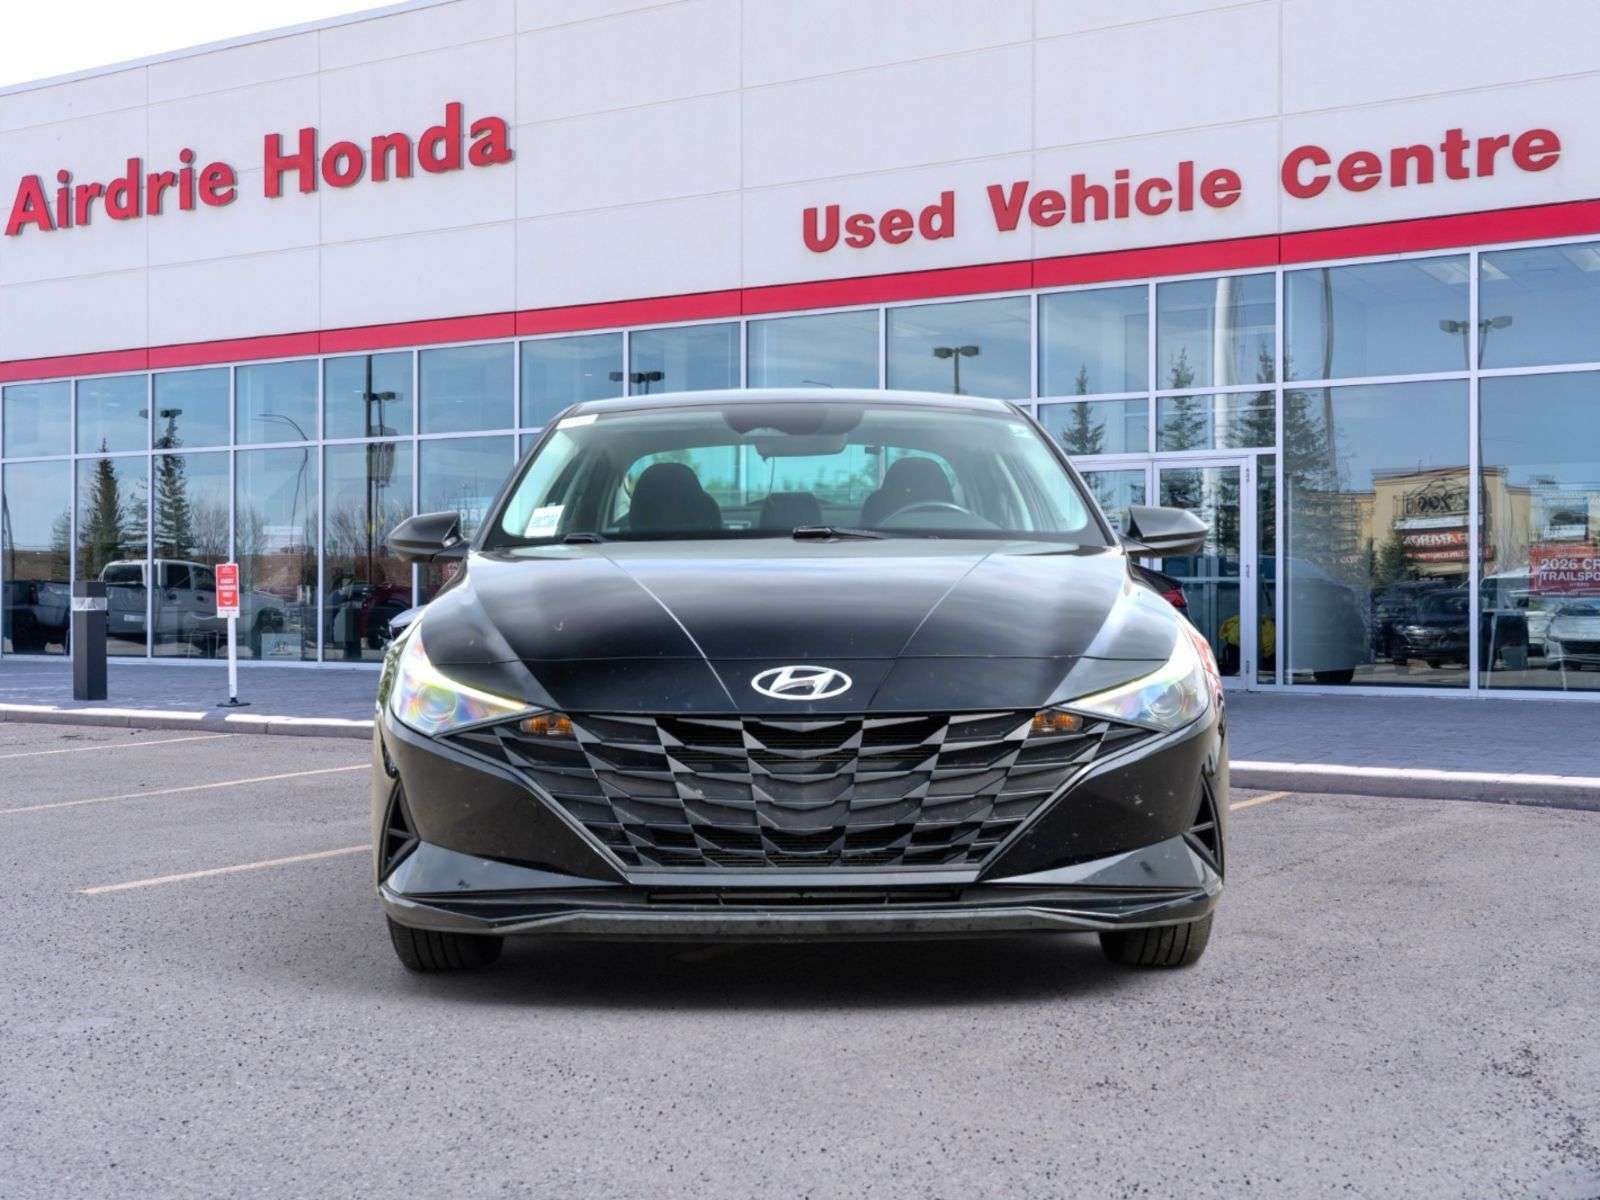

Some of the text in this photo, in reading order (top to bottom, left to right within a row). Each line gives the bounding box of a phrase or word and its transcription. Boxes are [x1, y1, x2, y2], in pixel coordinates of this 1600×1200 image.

[5, 102, 513, 236] Airdrie Honda
[803, 128, 1561, 253] Used Vehicle Centre
[1541, 558, 1578, 570] 2026
